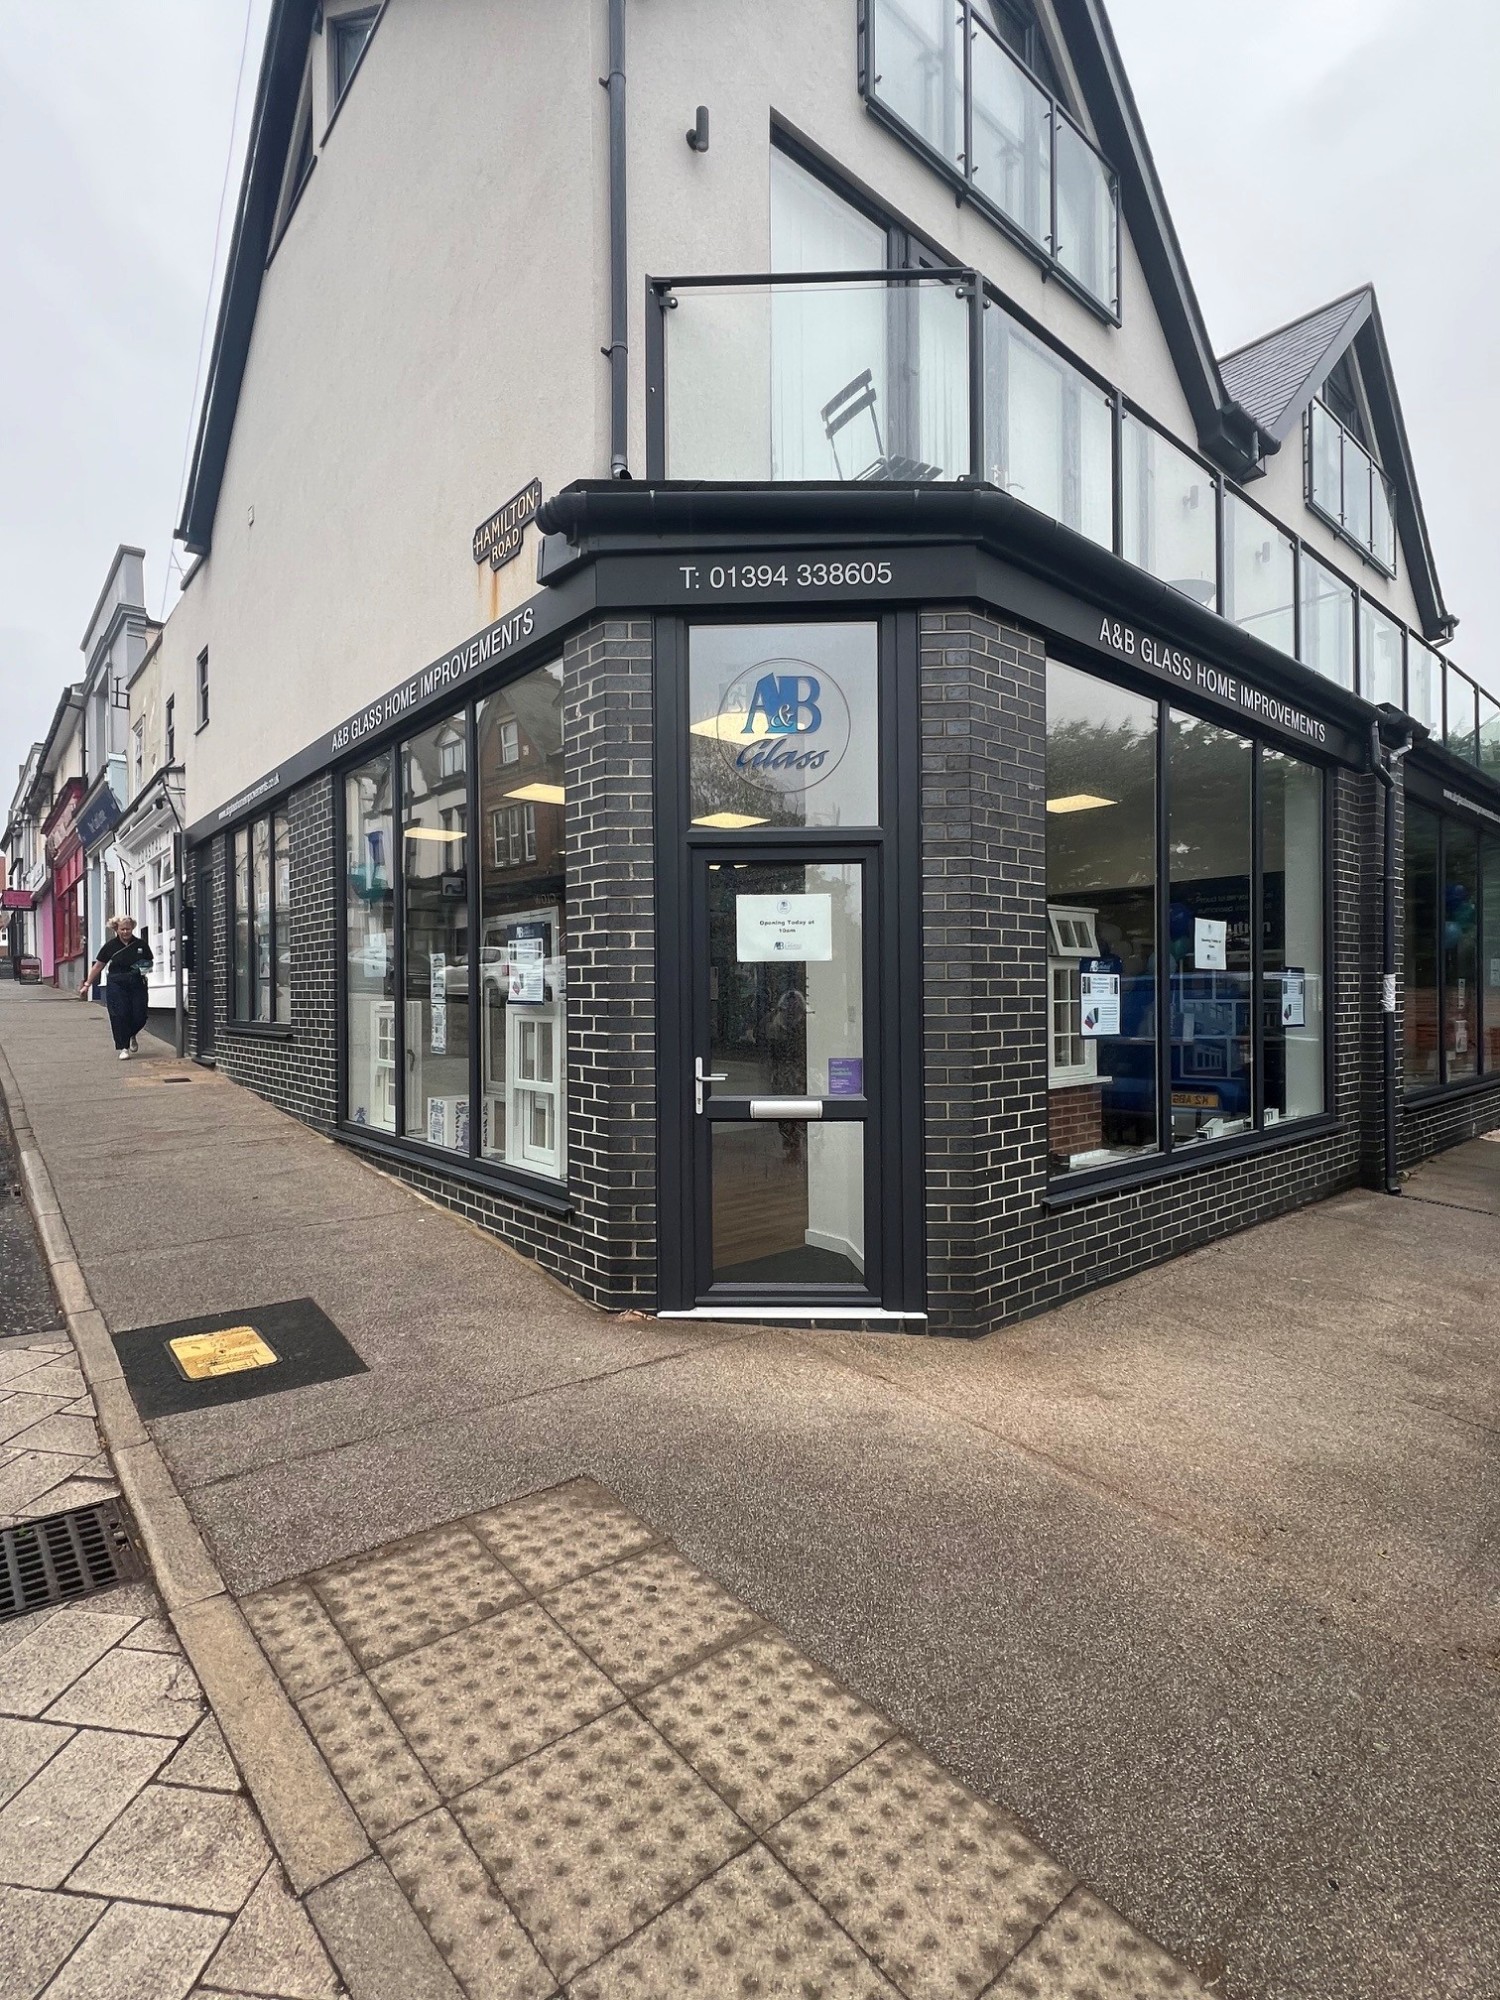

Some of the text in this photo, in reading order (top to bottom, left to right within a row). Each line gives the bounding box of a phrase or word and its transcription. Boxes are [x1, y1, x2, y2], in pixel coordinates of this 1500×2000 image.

[475, 487, 537, 555] HAMILTON
[491, 528, 520, 562] ROAD
[679, 562, 893, 589] T: 01394 338605
[331, 607, 535, 752] A&B GLASS HOME IMPROVEMENTS
[1099, 617, 1326, 743] A&B GLASS HOME IMPROVEMENTS
[735, 738, 830, 770] Glass
